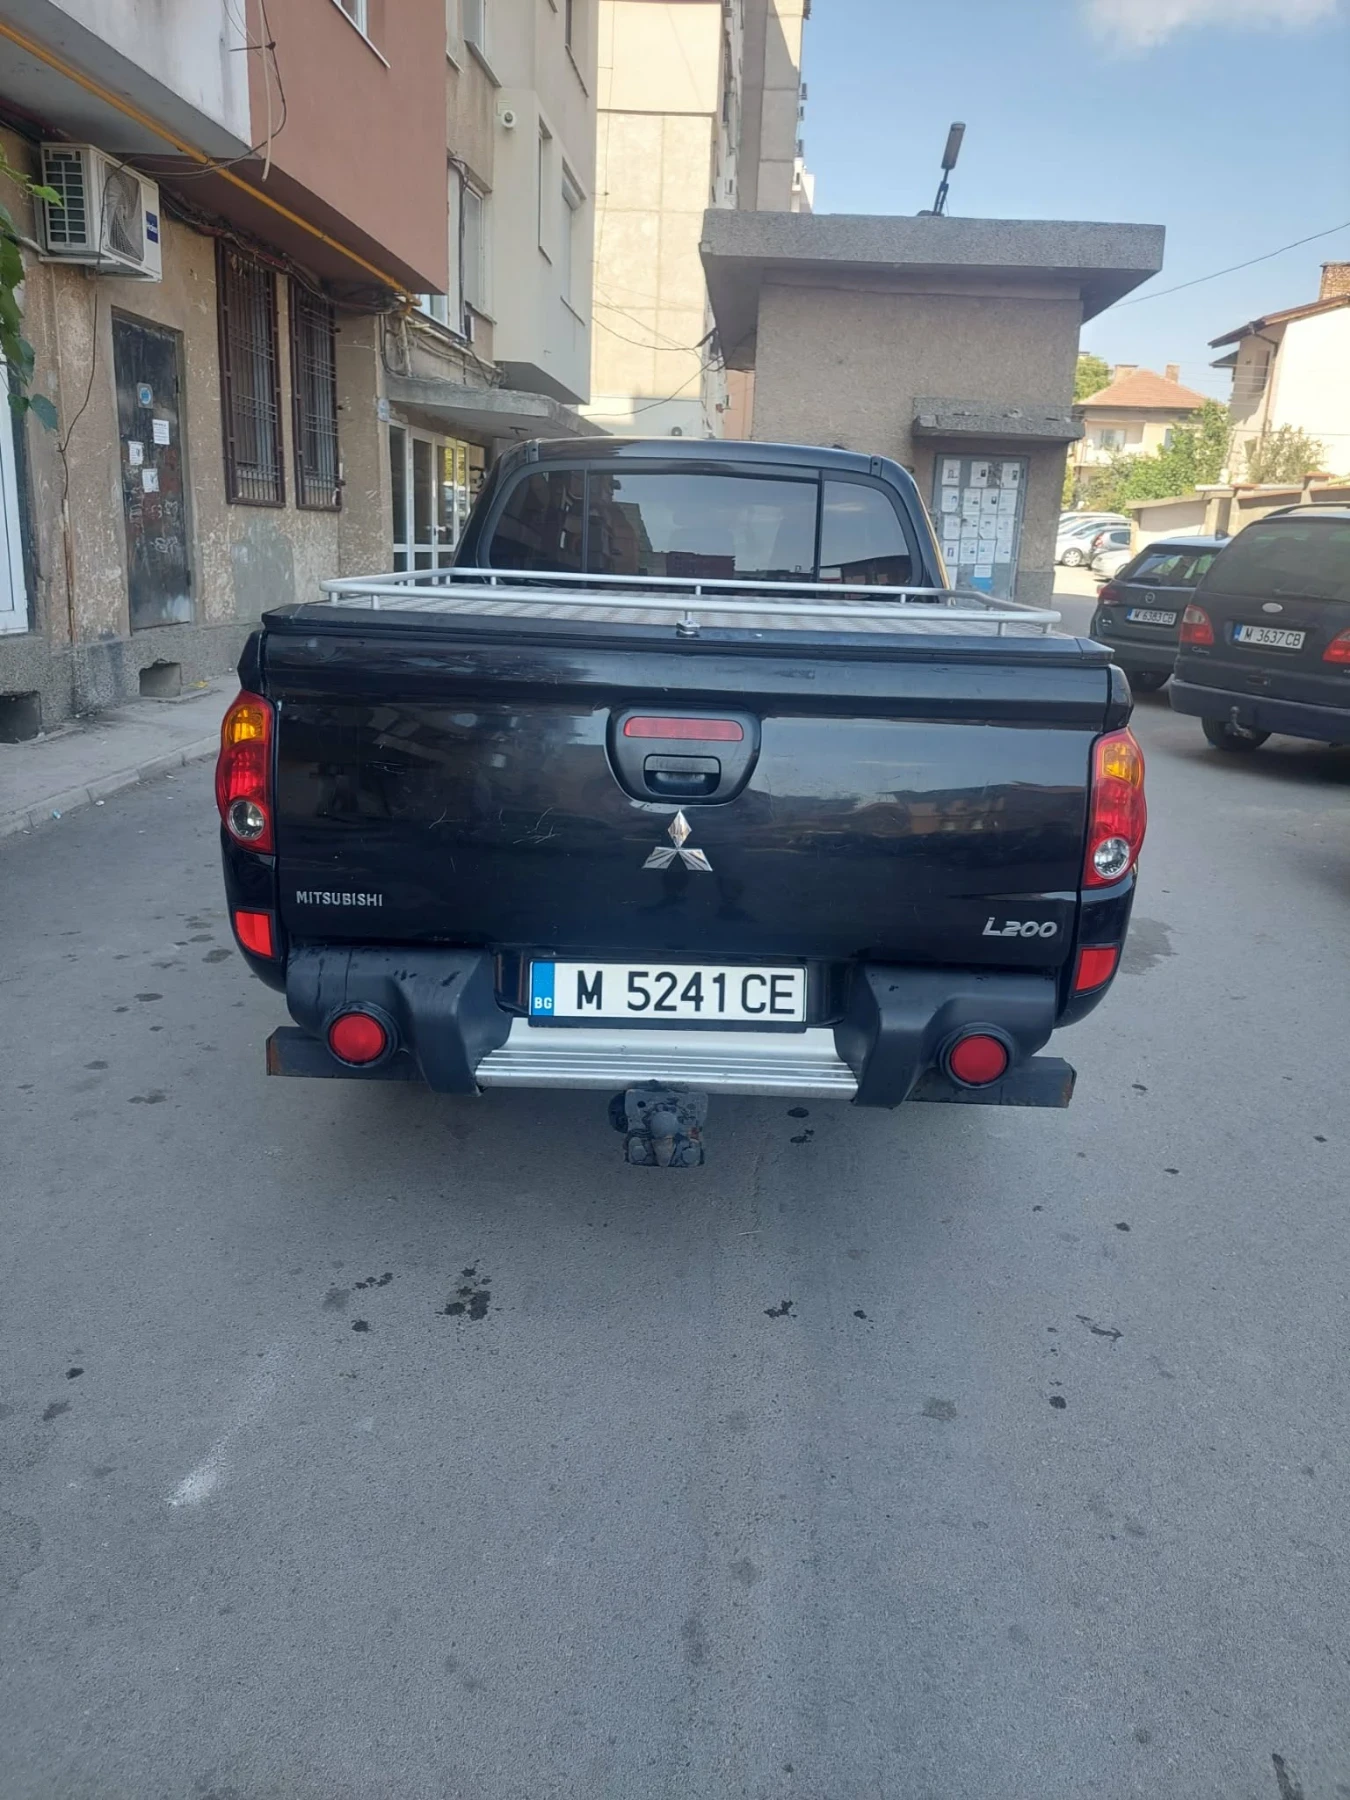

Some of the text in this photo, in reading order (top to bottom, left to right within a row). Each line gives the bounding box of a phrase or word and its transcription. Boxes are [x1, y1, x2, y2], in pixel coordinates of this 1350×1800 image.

[1256, 629, 1286, 645] 3637
[1285, 632, 1302, 647] CB
[296, 890, 383, 907] MITSUBISHI
[982, 916, 1058, 938] L200
[576, 970, 795, 1014] M 5241 CE
[534, 997, 552, 1009] BG
